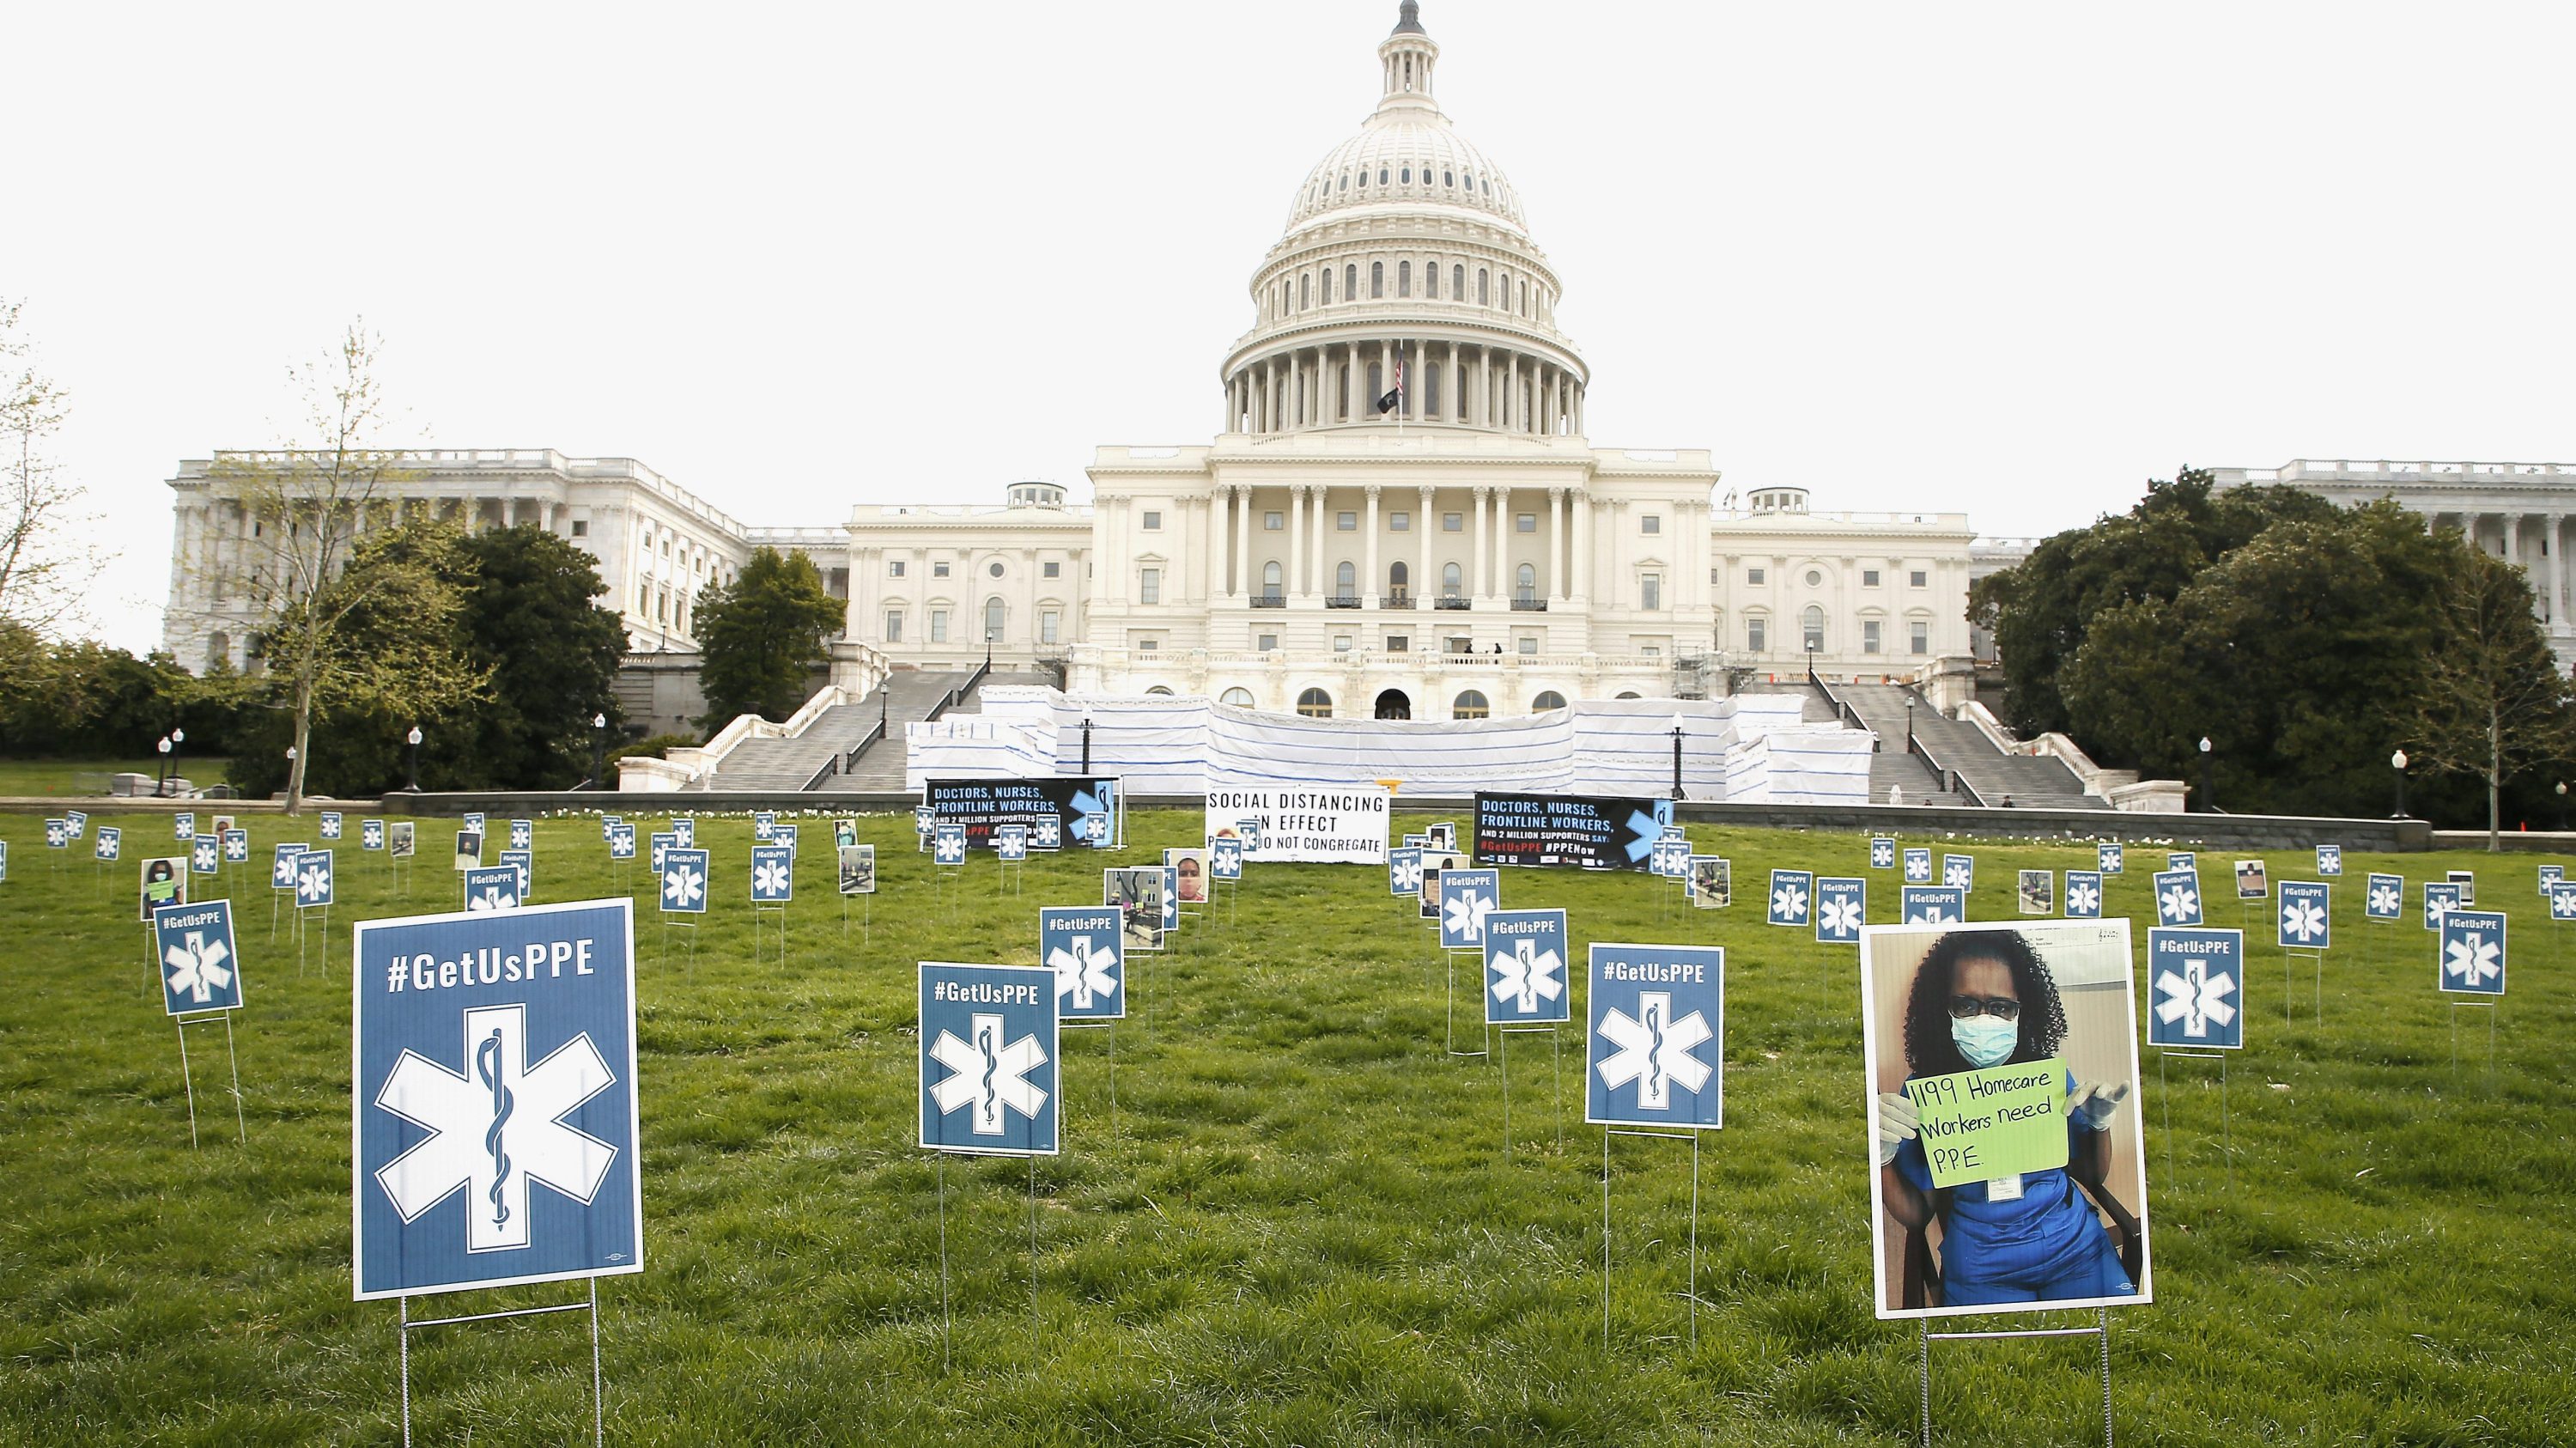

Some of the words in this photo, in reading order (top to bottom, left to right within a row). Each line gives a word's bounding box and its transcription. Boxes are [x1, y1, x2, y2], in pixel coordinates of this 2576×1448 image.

[935, 788, 991, 799] DOCTORS,
[996, 787, 1042, 799] NURSES,
[935, 801, 995, 812] FRONTLINE
[999, 800, 1058, 812] WORKERS,
[1210, 794, 1269, 808] SOCIAL
[1280, 794, 1382, 812] DISTANCING
[1482, 800, 1542, 814] DOCTORS,
[1548, 802, 1597, 817] NURSES,
[989, 814, 1036, 823] SUPPORTERS
[1280, 815, 1336, 831] EFFECT
[1482, 814, 1546, 827] FRONTLINE
[1552, 817, 1613, 833] WORKERS,
[1540, 832, 1589, 842] SUPPORTERS
[1278, 837, 1298, 849] NOT
[1304, 837, 1380, 852] CONGREGATE
[1480, 841, 1541, 852] #GetUsPPE
[1546, 843, 1595, 856] #PPENow
[471, 873, 512, 884] #GetUsPPE
[1447, 877, 1490, 885] #GetUsPPE
[1910, 894, 1955, 903] #GetUsPPE
[2285, 888, 2322, 897] #GetUsPPE
[163, 912, 220, 928] #GetUsPPE
[1050, 918, 1111, 930] #GetUsPPE
[2450, 919, 2497, 929] #GetUsPPE
[1492, 921, 1555, 934] #GetUsPPE
[2160, 940, 2229, 953] #GetUsPPE
[388, 940, 593, 992] #GetUsPPE
[1604, 962, 1704, 983] #GetUsPPE
[935, 982, 1038, 1004] #GetUsPPE
[1910, 1077, 1957, 1108] 1199
[1967, 1072, 2052, 1101] Homecare
[1920, 1113, 1990, 1140] Workers
[1997, 1096, 2051, 1123] need
